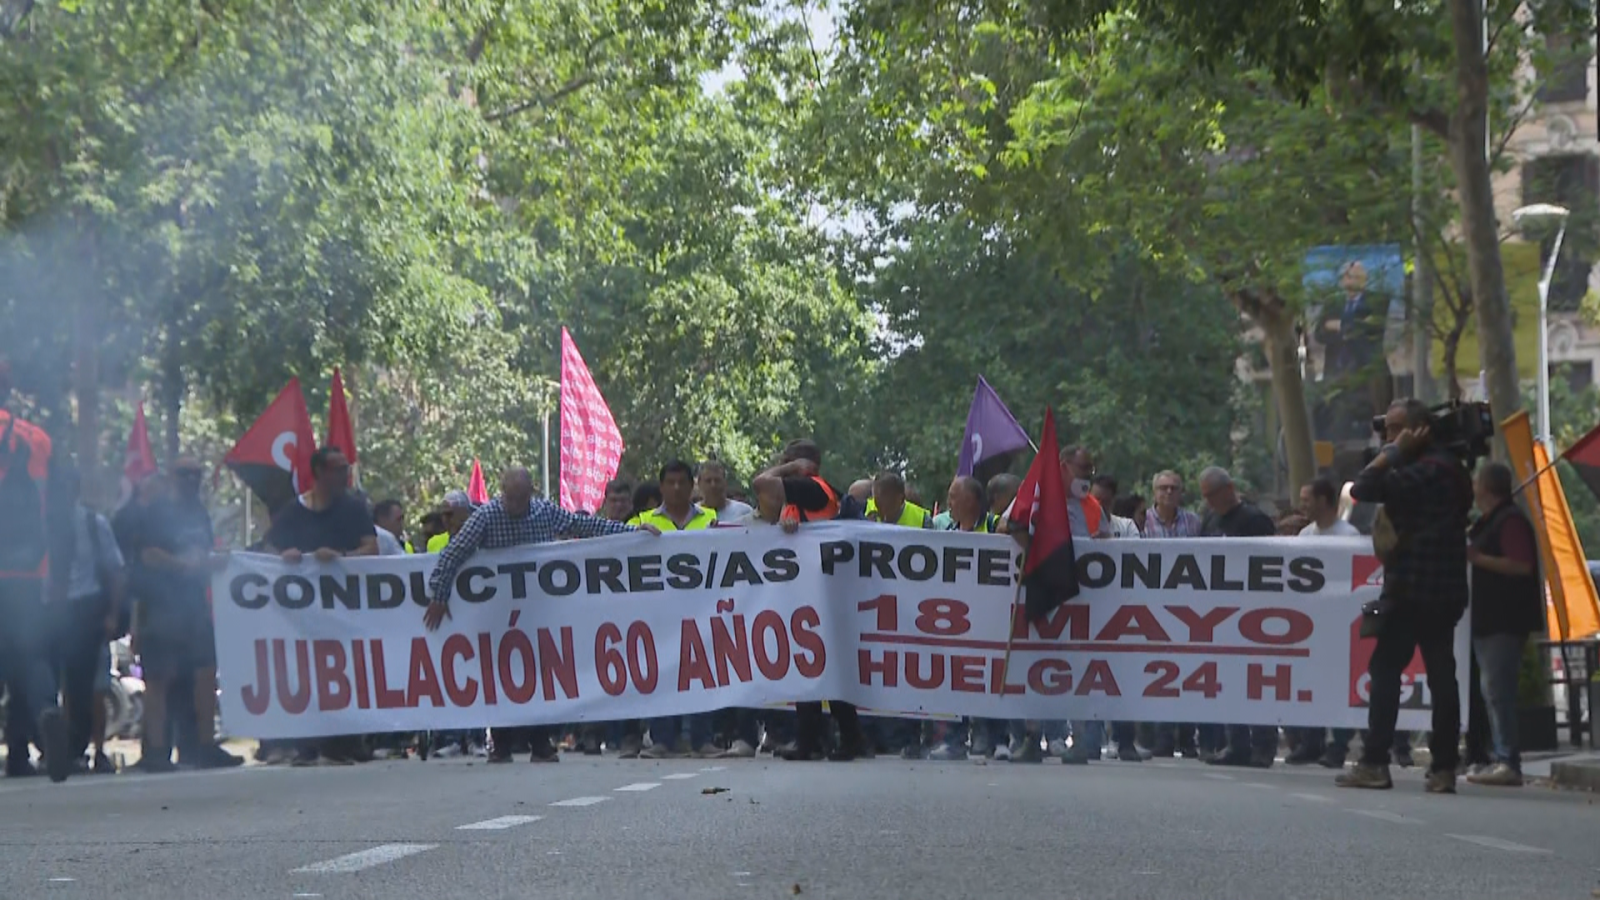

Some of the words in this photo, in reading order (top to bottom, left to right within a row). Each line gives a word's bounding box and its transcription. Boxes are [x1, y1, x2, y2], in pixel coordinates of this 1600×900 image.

[820, 541, 1326, 593] PROFEONALES
[857, 594, 971, 636] 18
[1011, 603, 1314, 644] MAYO
[241, 610, 580, 716] JUBILACIÓN
[594, 619, 659, 697] 60
[677, 598, 827, 693] AÑOS
[857, 649, 1122, 697] HUELGA
[1143, 659, 1222, 700] 24
[1246, 664, 1313, 702] H.
